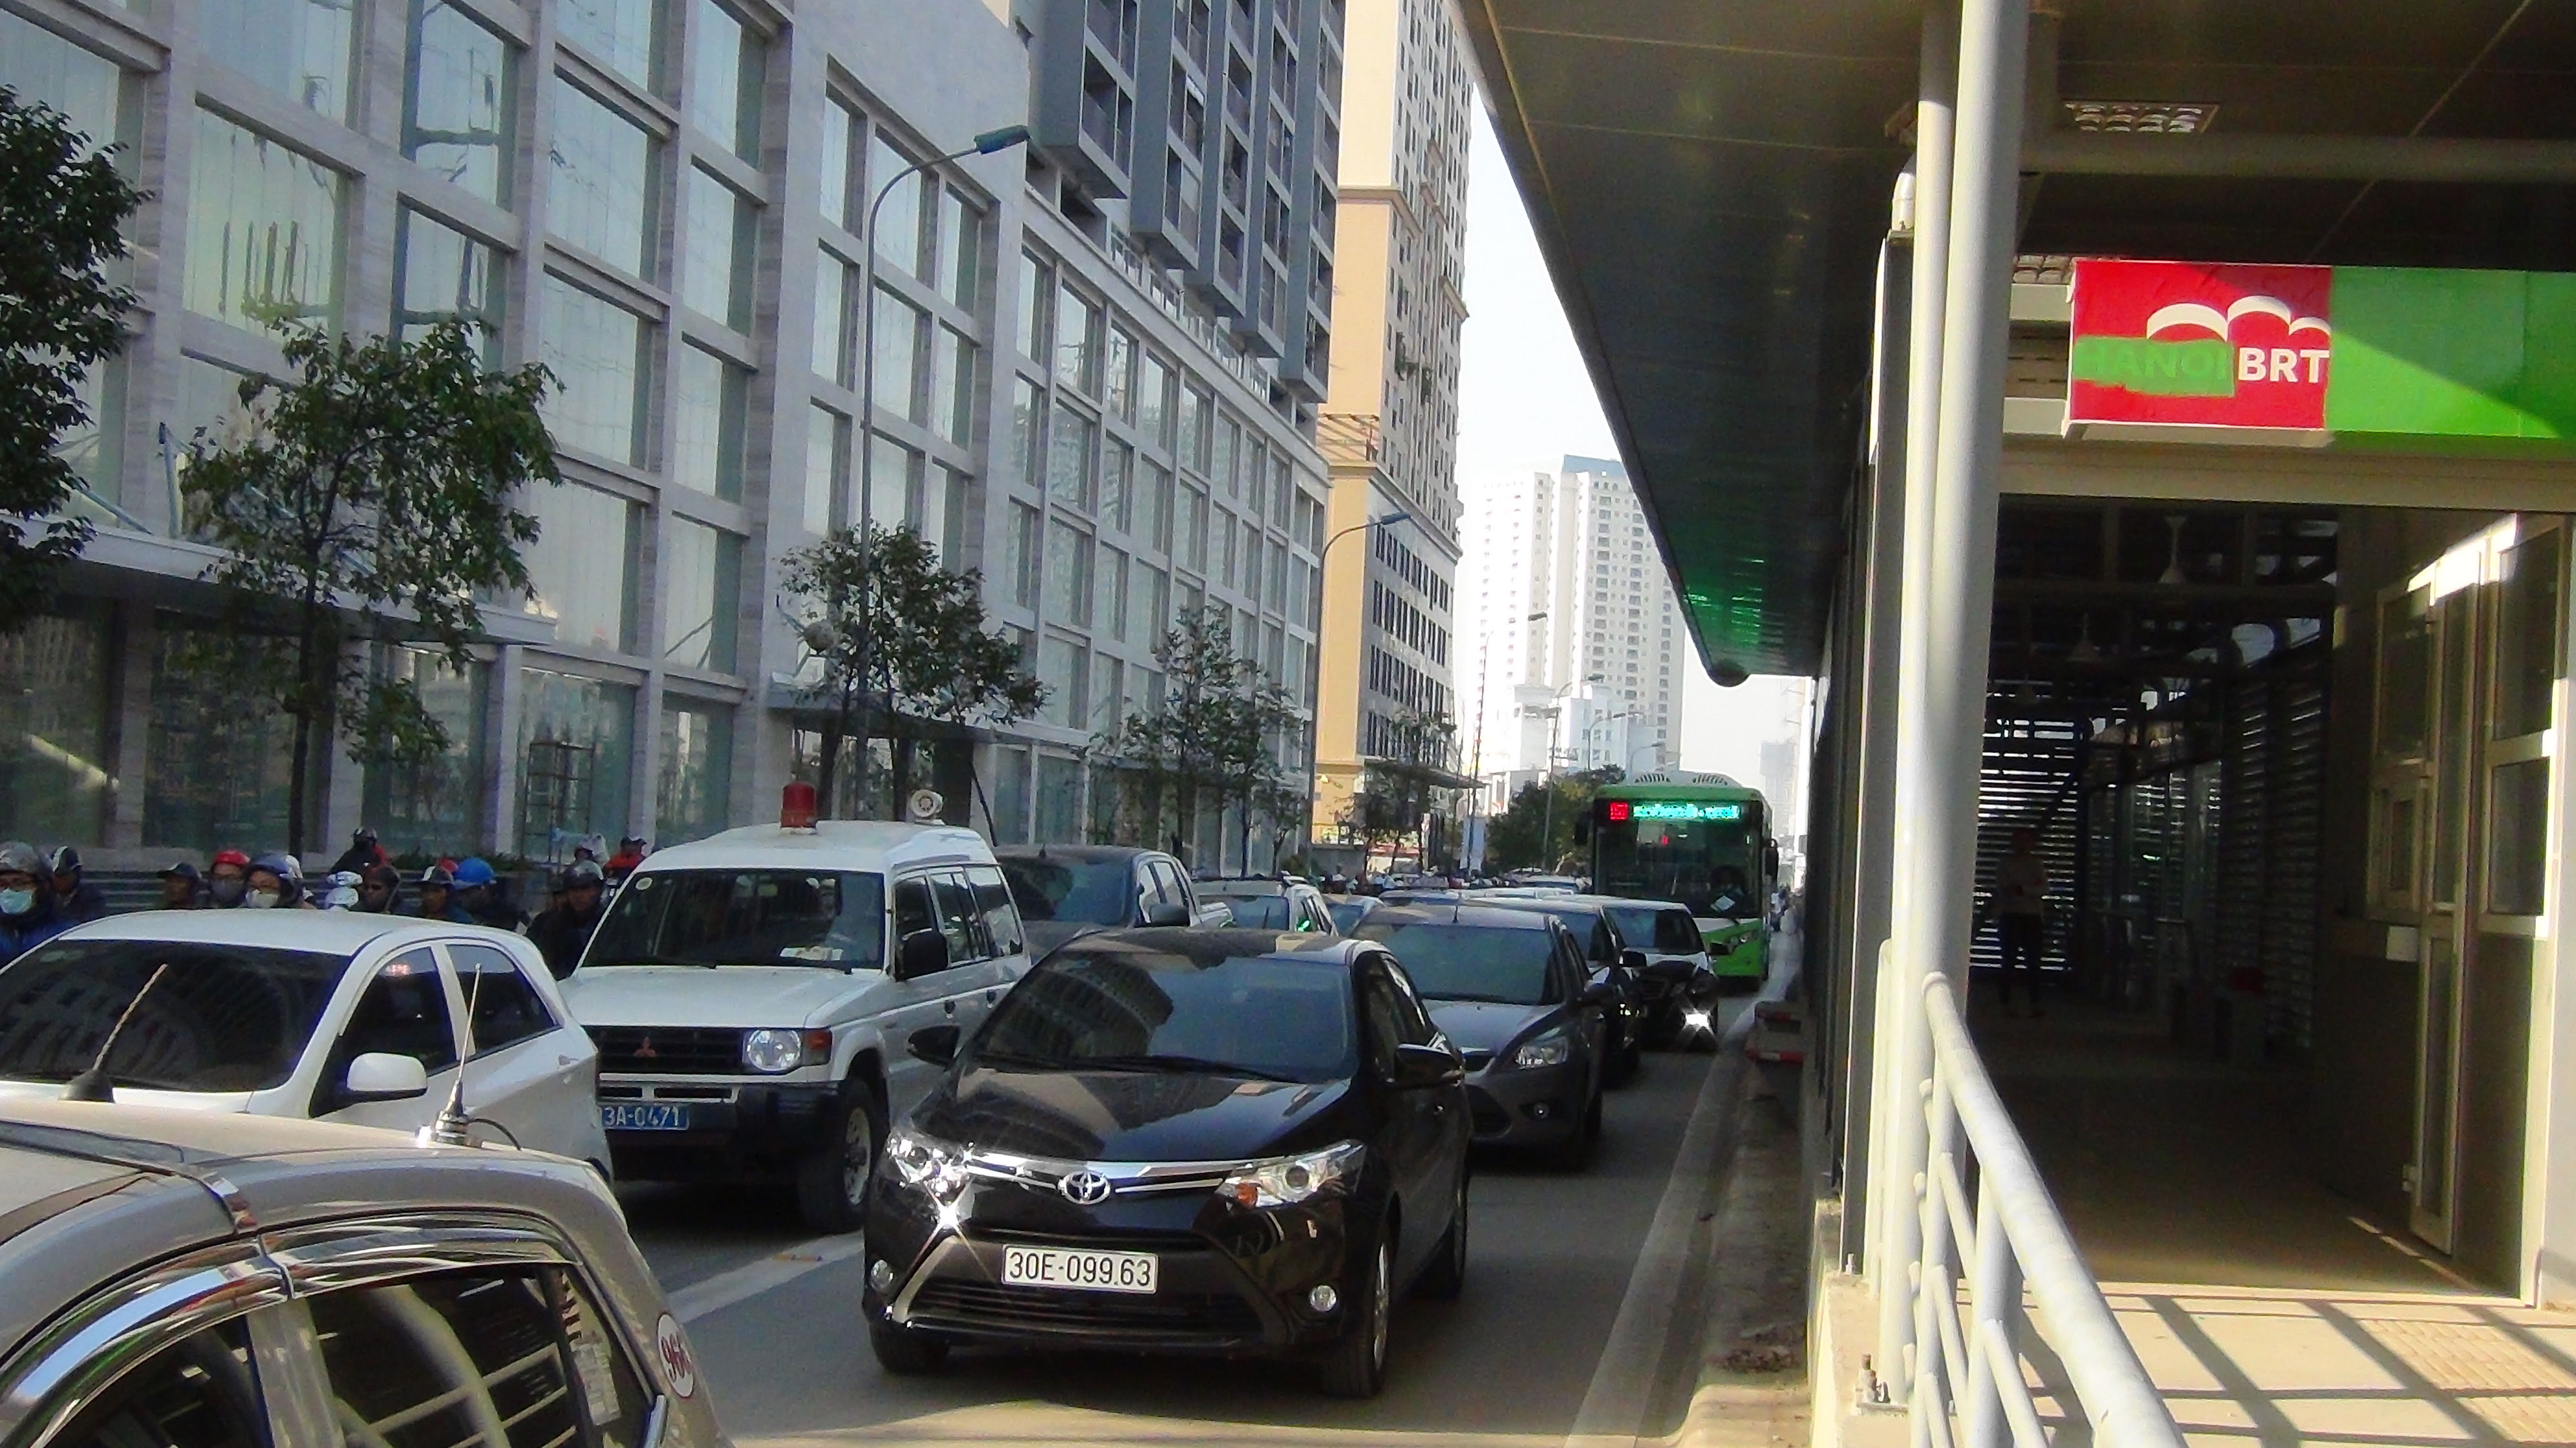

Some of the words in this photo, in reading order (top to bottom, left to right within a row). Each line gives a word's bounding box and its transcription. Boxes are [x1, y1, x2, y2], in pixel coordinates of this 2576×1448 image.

[2238, 347, 2330, 383] BRT
[604, 1106, 679, 1127] 3A-0471
[1009, 1251, 1152, 1287] 30E-099.63
